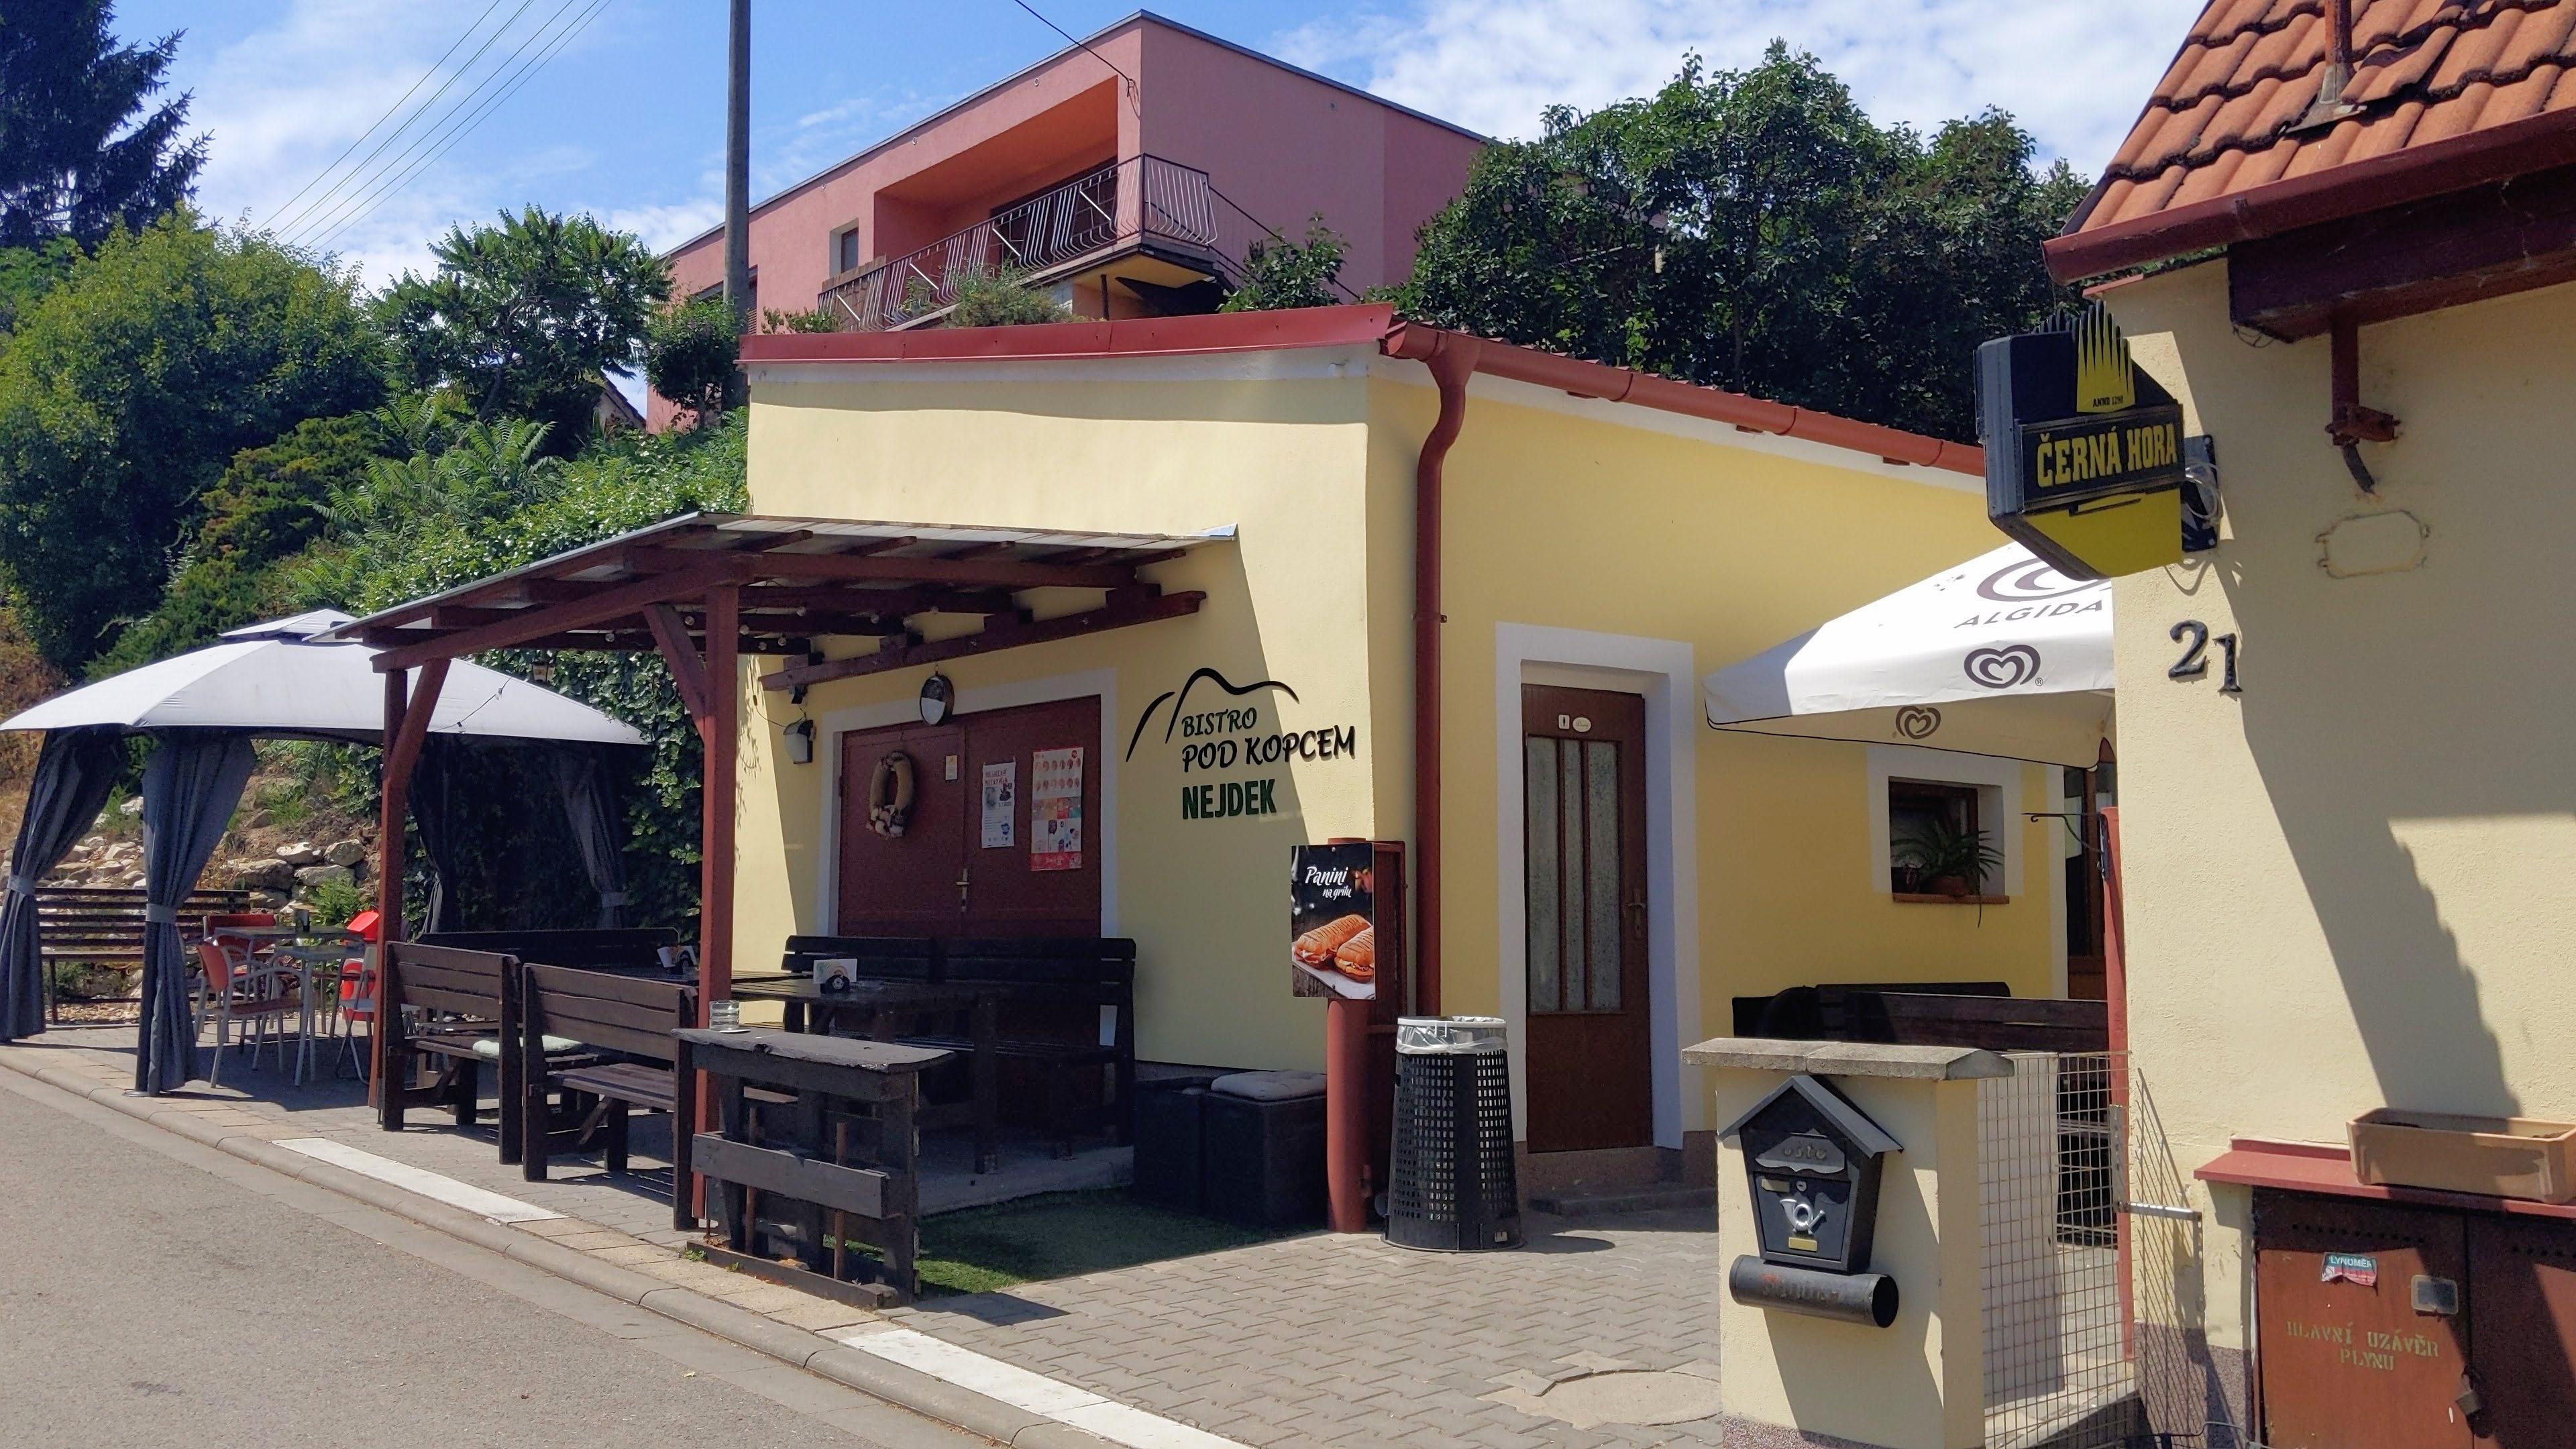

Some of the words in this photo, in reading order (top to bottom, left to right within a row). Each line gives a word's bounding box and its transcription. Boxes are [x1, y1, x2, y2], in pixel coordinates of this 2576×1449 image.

[2037, 425, 2123, 488] ČERNÁ
[2127, 423, 2178, 471] HORA
[1953, 600, 2103, 629] ALGIDA
[2168, 619, 2243, 692] 21
[1181, 707, 1258, 738] BISTRO
[1181, 739, 1238, 773] POD
[1245, 724, 1356, 765] KOPCEM
[1182, 779, 1277, 820] NEJDEK
[1305, 866, 1349, 886] Panini
[1322, 888, 1333, 898] na
[1333, 885, 1352, 901] grilu
[2328, 1256, 2372, 1268] LYNOMĚR
[2286, 1322, 2353, 1345] HLAVNÍ
[2367, 1328, 2439, 1357] UZÁVĚR
[2339, 1348, 2395, 1371] PLYNU
